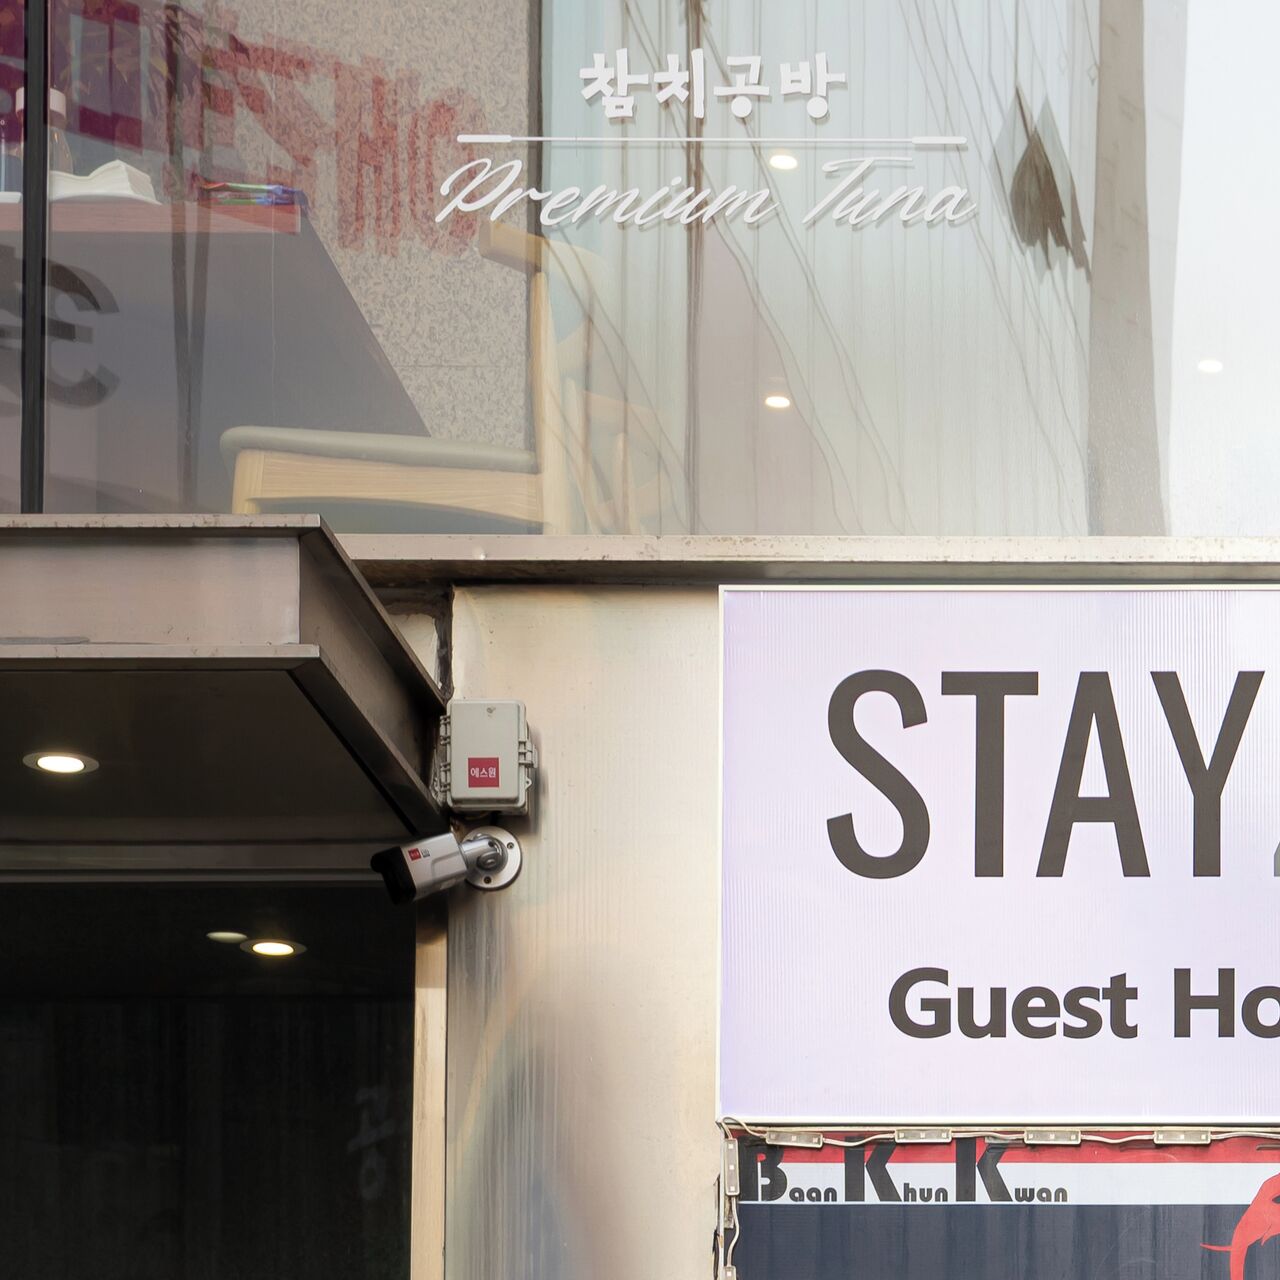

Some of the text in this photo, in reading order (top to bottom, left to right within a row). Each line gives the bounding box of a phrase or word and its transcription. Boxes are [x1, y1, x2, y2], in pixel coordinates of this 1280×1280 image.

[580, 48, 846, 118] 참치공방
[434, 155, 978, 227] Premium Tuna
[470, 766, 496, 778] 에스원
[888, 966, 1140, 1039] Guest
[739, 1135, 1068, 1203] Baan Khun Kwan
